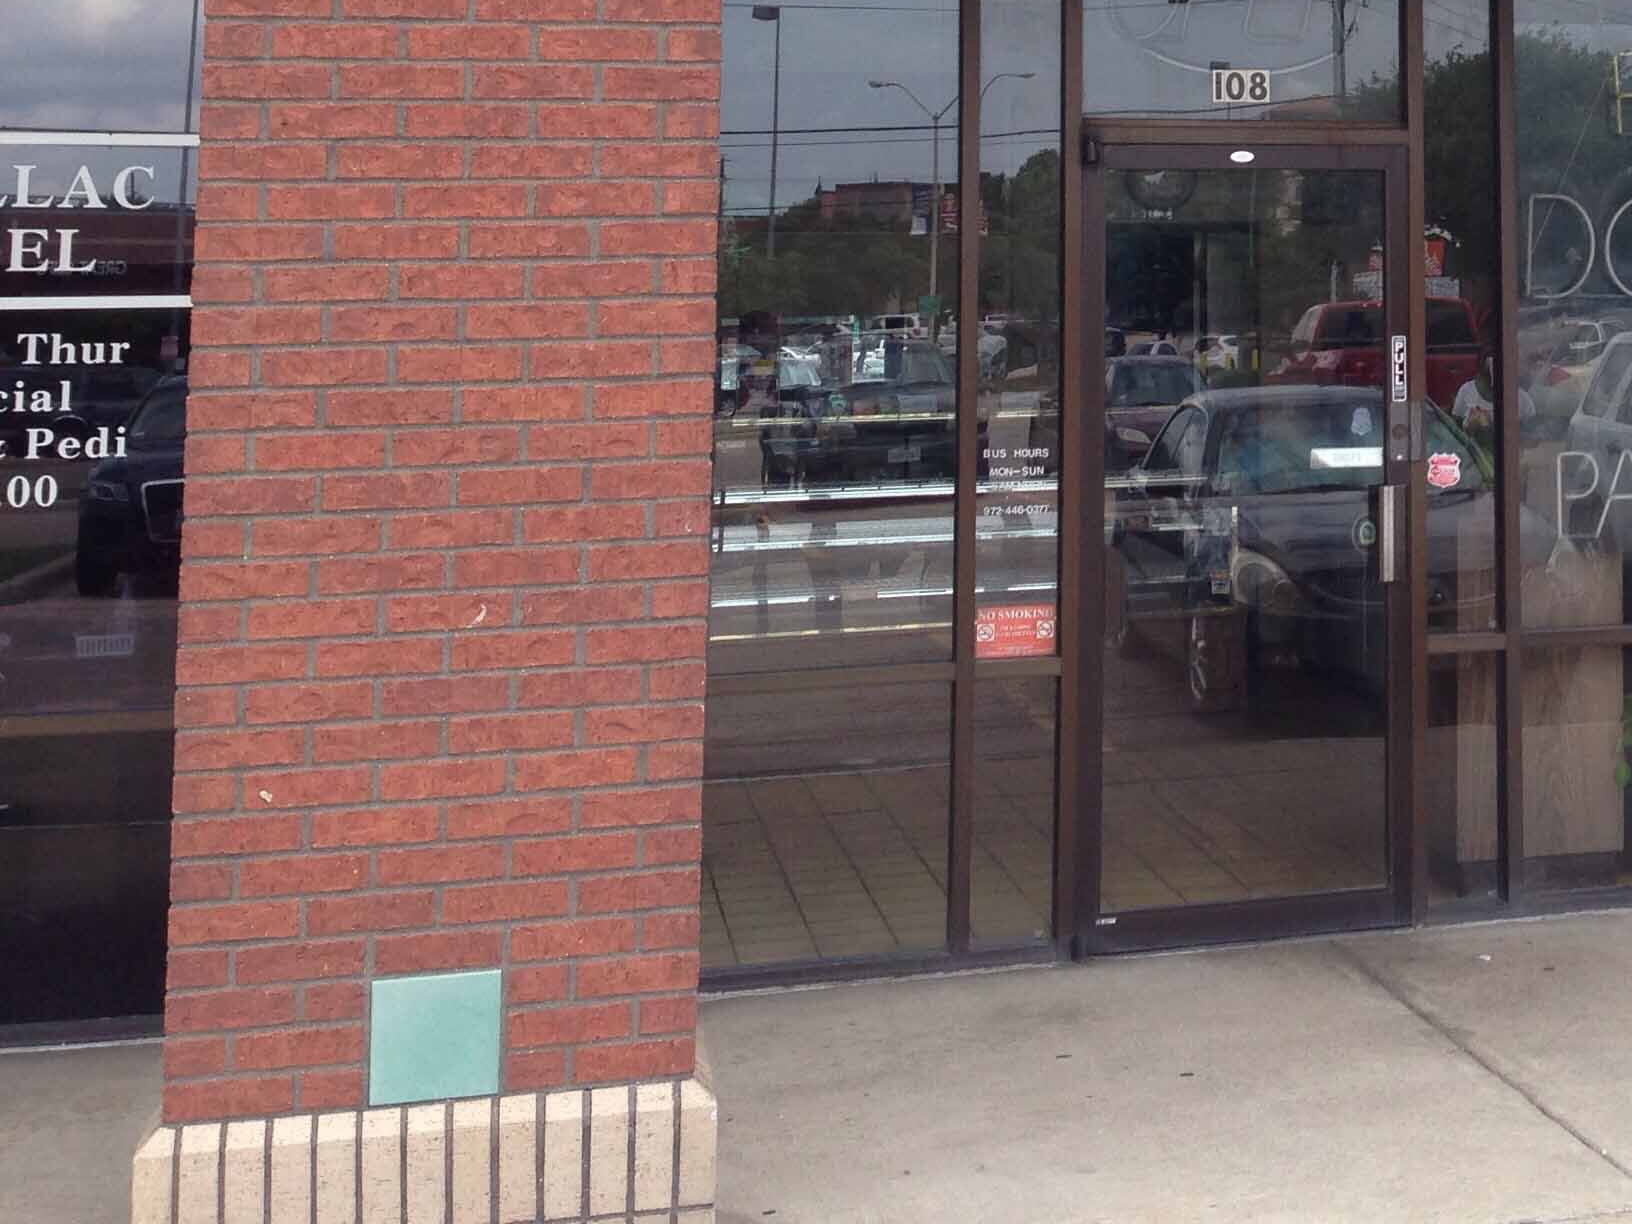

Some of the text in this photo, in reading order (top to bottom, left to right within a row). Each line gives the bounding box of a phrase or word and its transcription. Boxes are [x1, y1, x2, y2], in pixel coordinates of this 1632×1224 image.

[1214, 71, 1268, 101] 108
[0, 164, 156, 210] LAC
[17, 333, 131, 365] Thur
[1394, 341, 1405, 386] PULL
[24, 426, 129, 460] Pedi
[983, 448, 1049, 458] BUS HOURS
[989, 465, 1045, 477] MON-SUN
